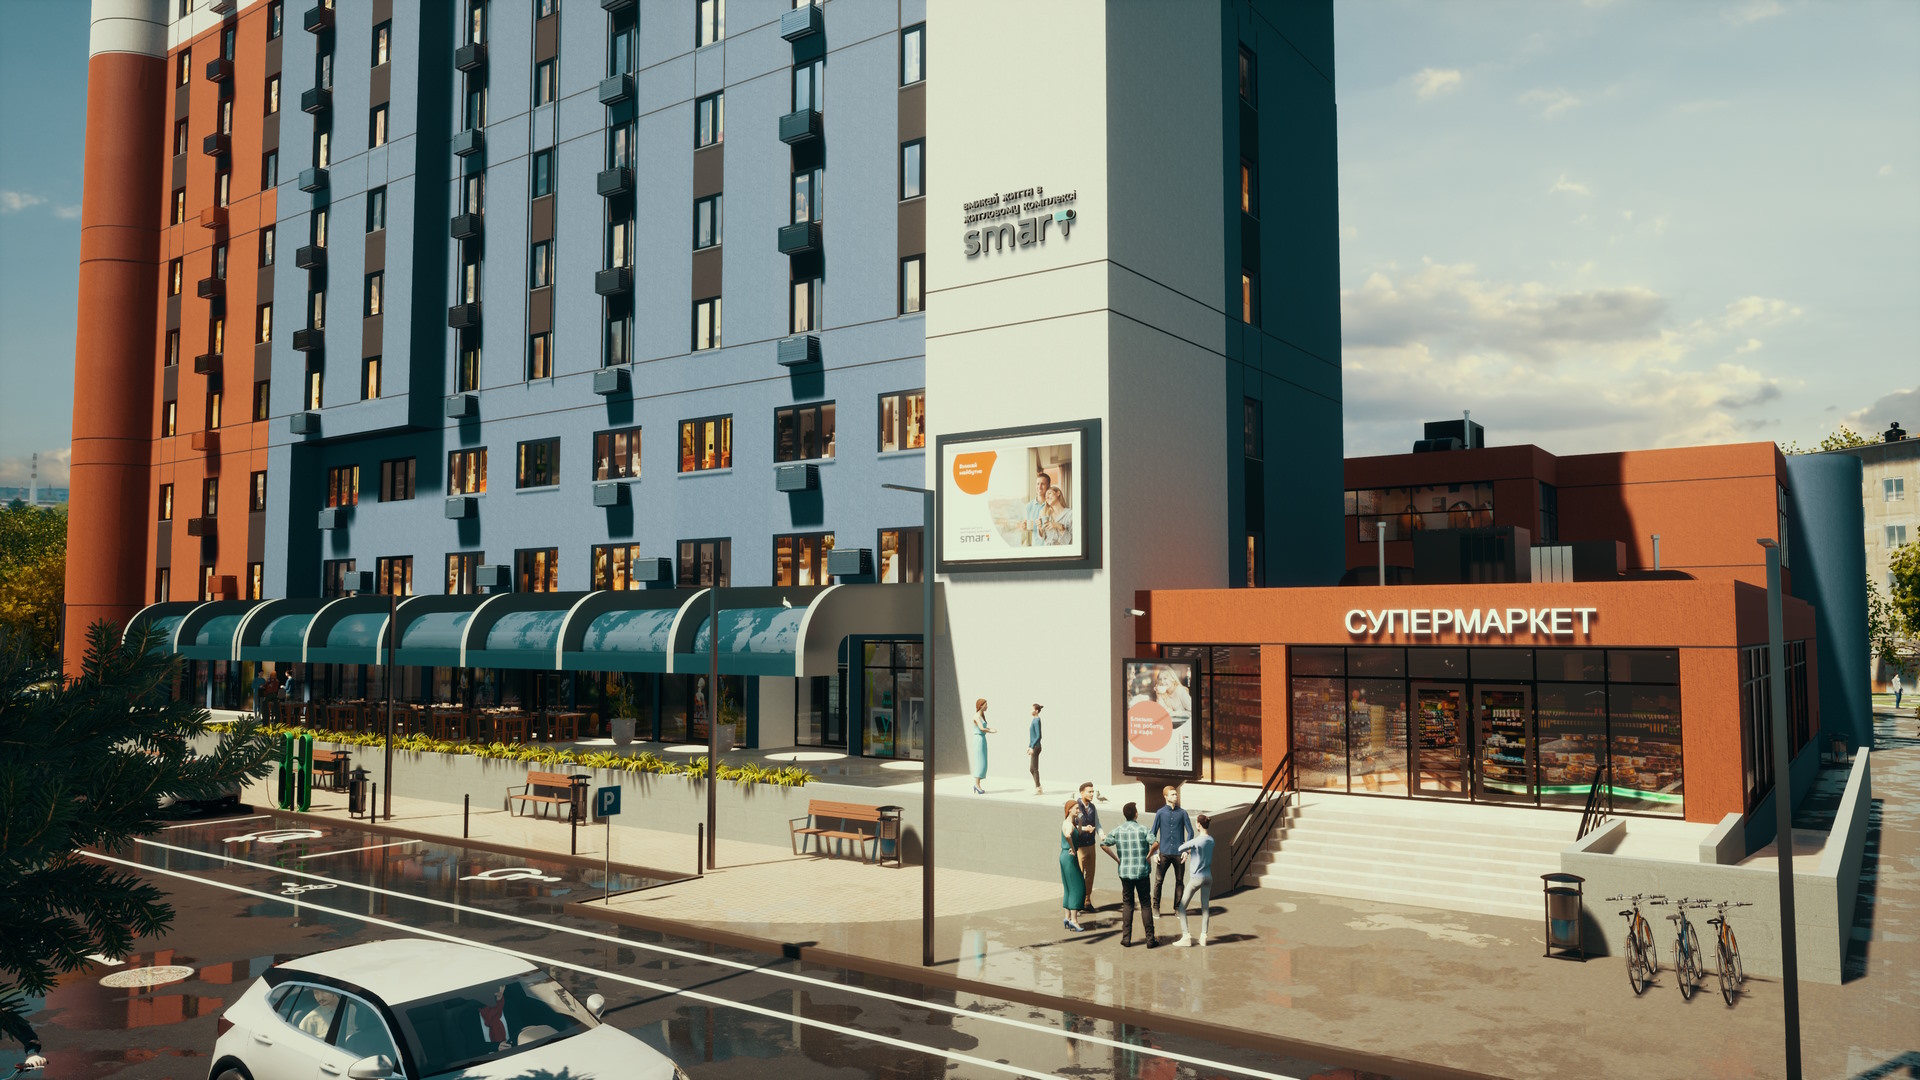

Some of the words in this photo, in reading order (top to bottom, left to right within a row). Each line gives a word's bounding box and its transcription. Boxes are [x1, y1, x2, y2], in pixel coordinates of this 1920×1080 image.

[963, 193, 999, 211] вмикай
[1002, 187, 1034, 202] життя
[964, 204, 1021, 224] житловому
[1023, 190, 1077, 211] комплексі
[963, 209, 1077, 257] smart
[960, 534, 990, 543] smart
[1345, 607, 1597, 634] СУПЕРМАРКЕТ
[1182, 735, 1190, 767] smart
[603, 791, 615, 811] P
